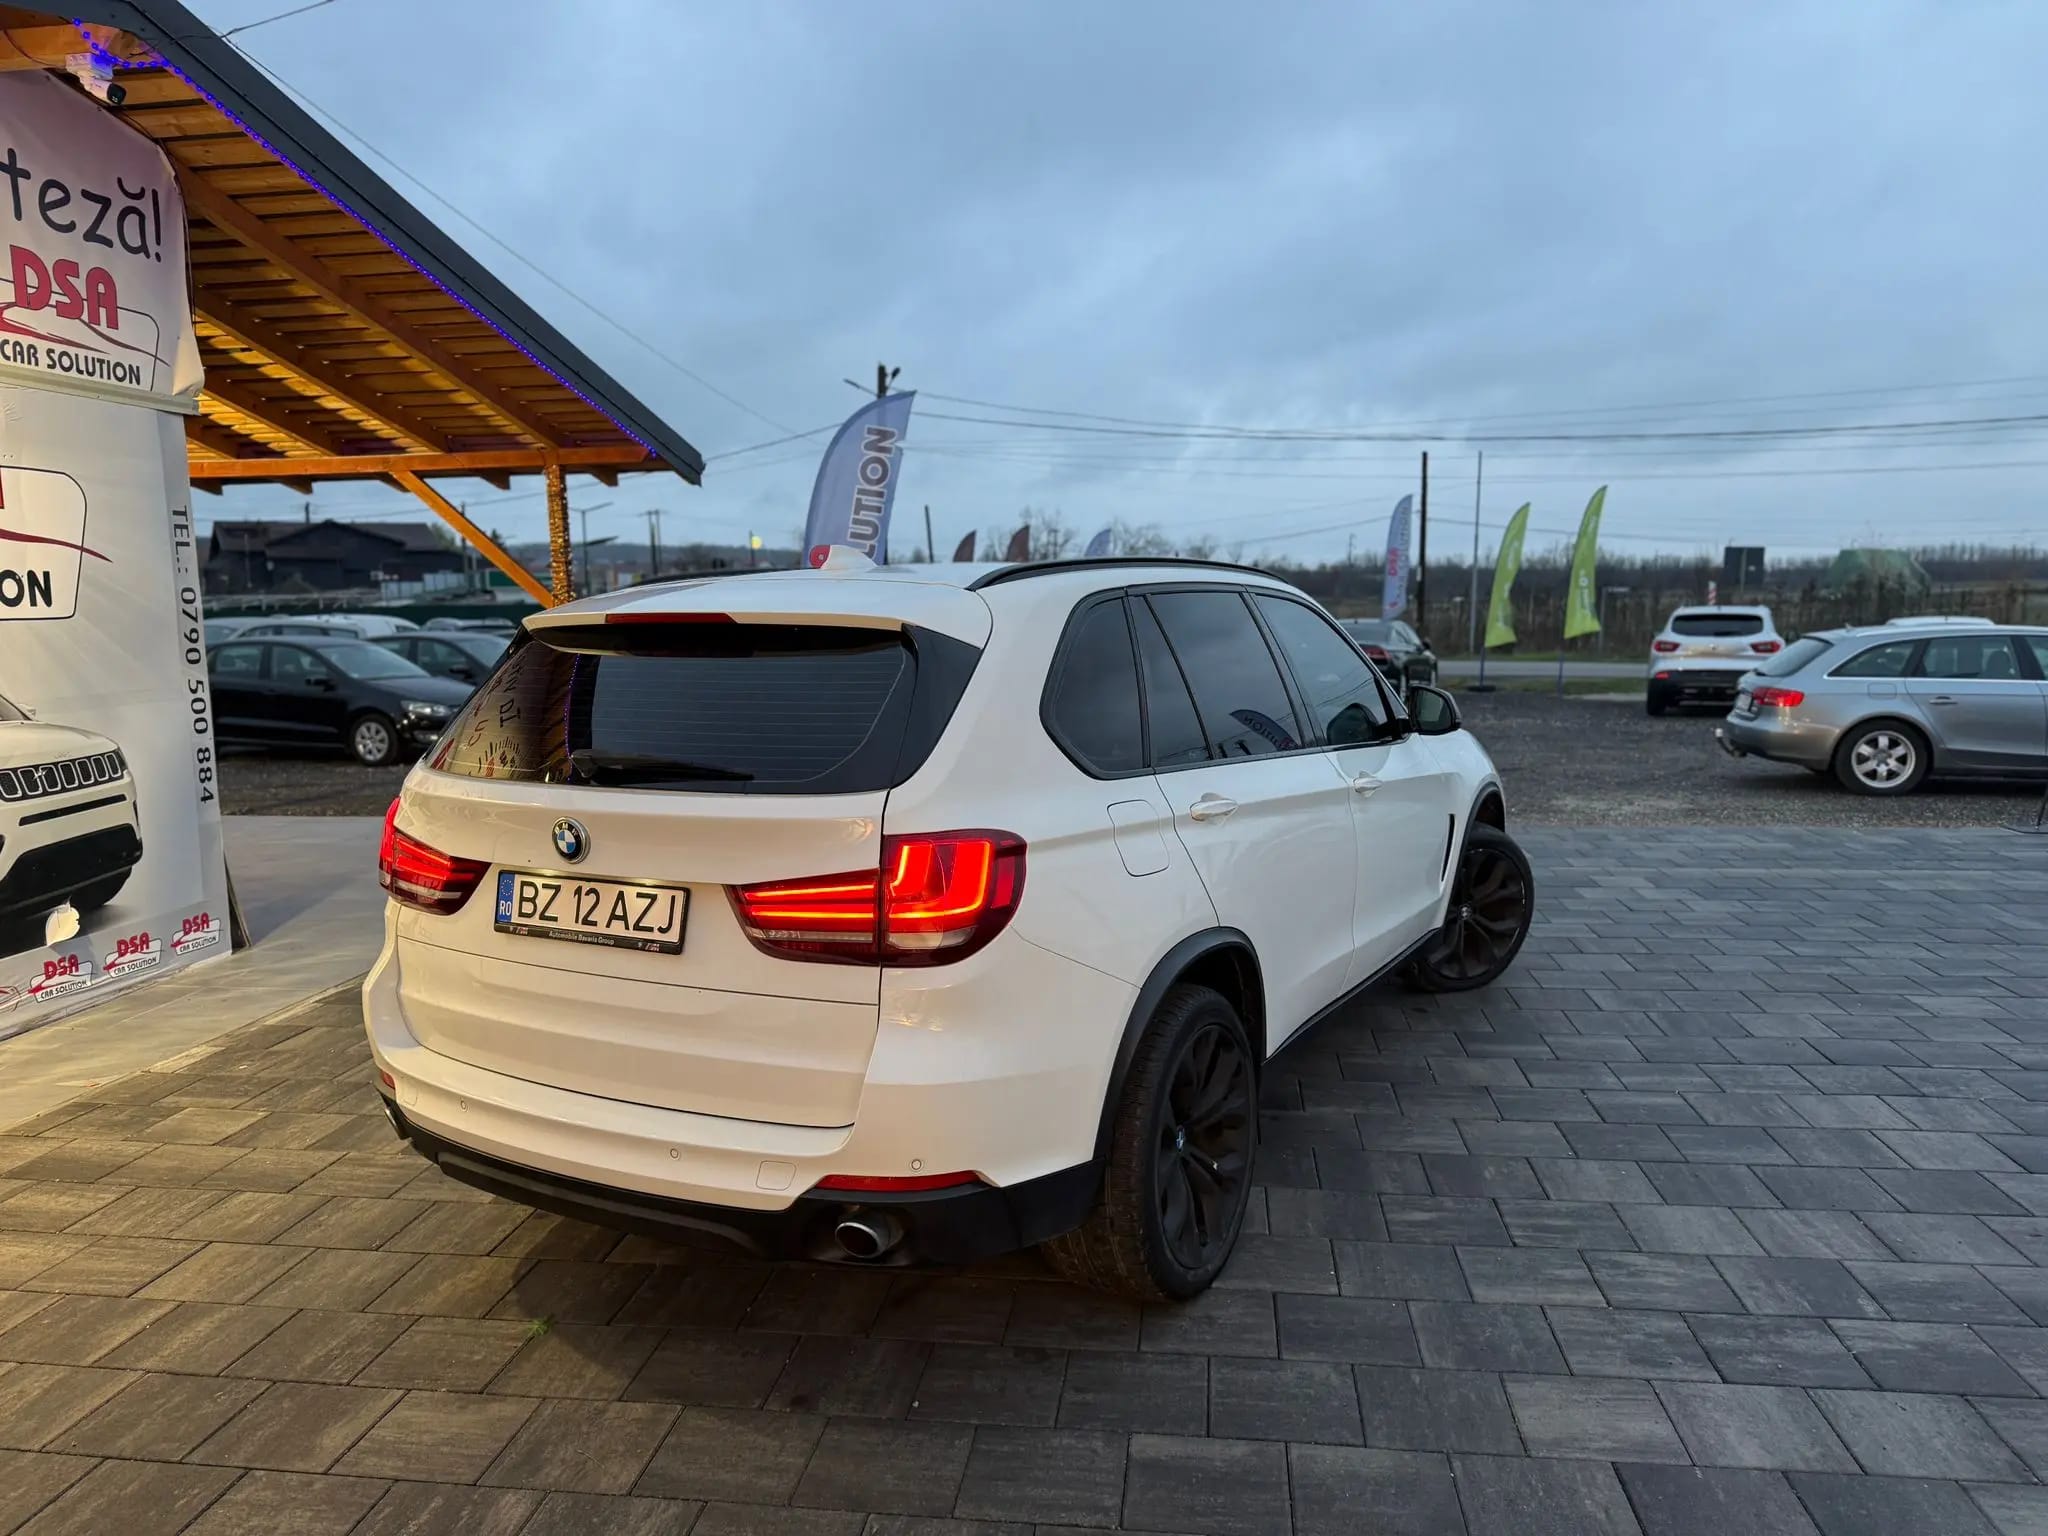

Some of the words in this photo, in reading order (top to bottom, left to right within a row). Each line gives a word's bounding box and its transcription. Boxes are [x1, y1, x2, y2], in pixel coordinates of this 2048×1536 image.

[10, 244, 119, 330] DSA
[0, 339, 39, 367] CAR
[47, 349, 141, 386] SOLUTION
[181, 587, 201, 665] 0790
[188, 679, 209, 735] 500
[196, 747, 215, 804] 884
[500, 900, 512, 916] RO
[518, 880, 561, 922] BZ
[573, 885, 600, 926] 12
[605, 890, 676, 934] AZJ
[182, 912, 209, 936] DSA
[117, 932, 149, 958] DSA
[191, 936, 217, 949] SOLUTION
[43, 954, 79, 980] DSA
[114, 966, 125, 975] CAR
[127, 957, 157, 971] SOLUTION
[40, 989, 54, 999] CAR
[55, 979, 87, 994] SOLUTION
